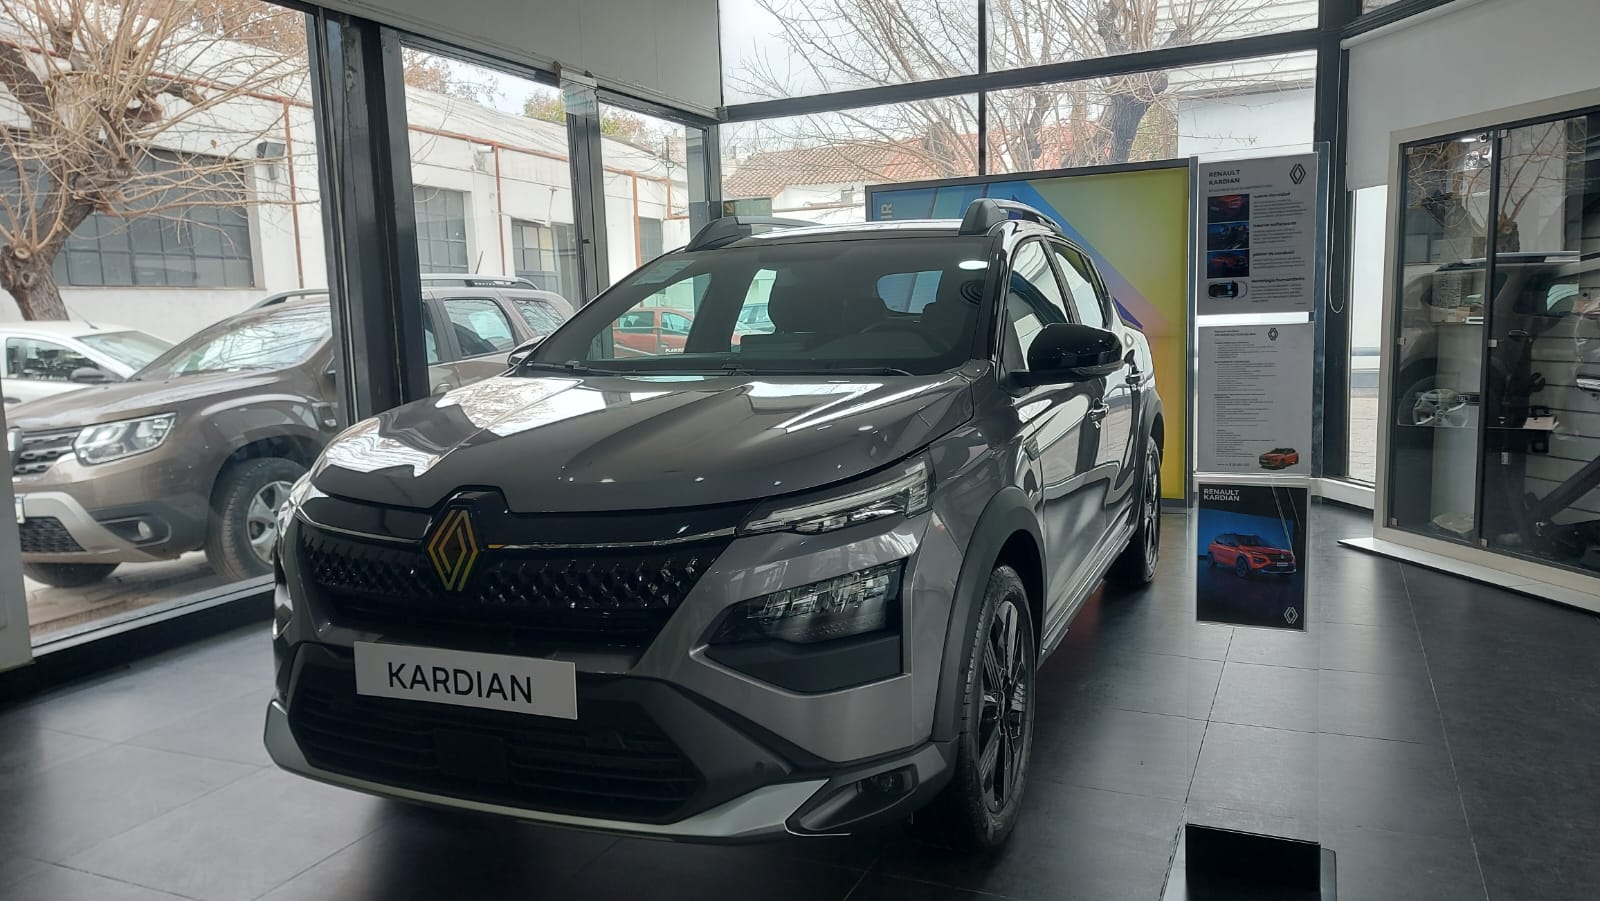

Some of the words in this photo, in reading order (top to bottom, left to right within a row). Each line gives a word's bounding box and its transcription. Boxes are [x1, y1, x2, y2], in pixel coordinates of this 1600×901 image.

[1203, 488, 1239, 496] RENAULT
[1203, 494, 1239, 502] KARDIAN
[387, 661, 532, 704] KARDIAN
